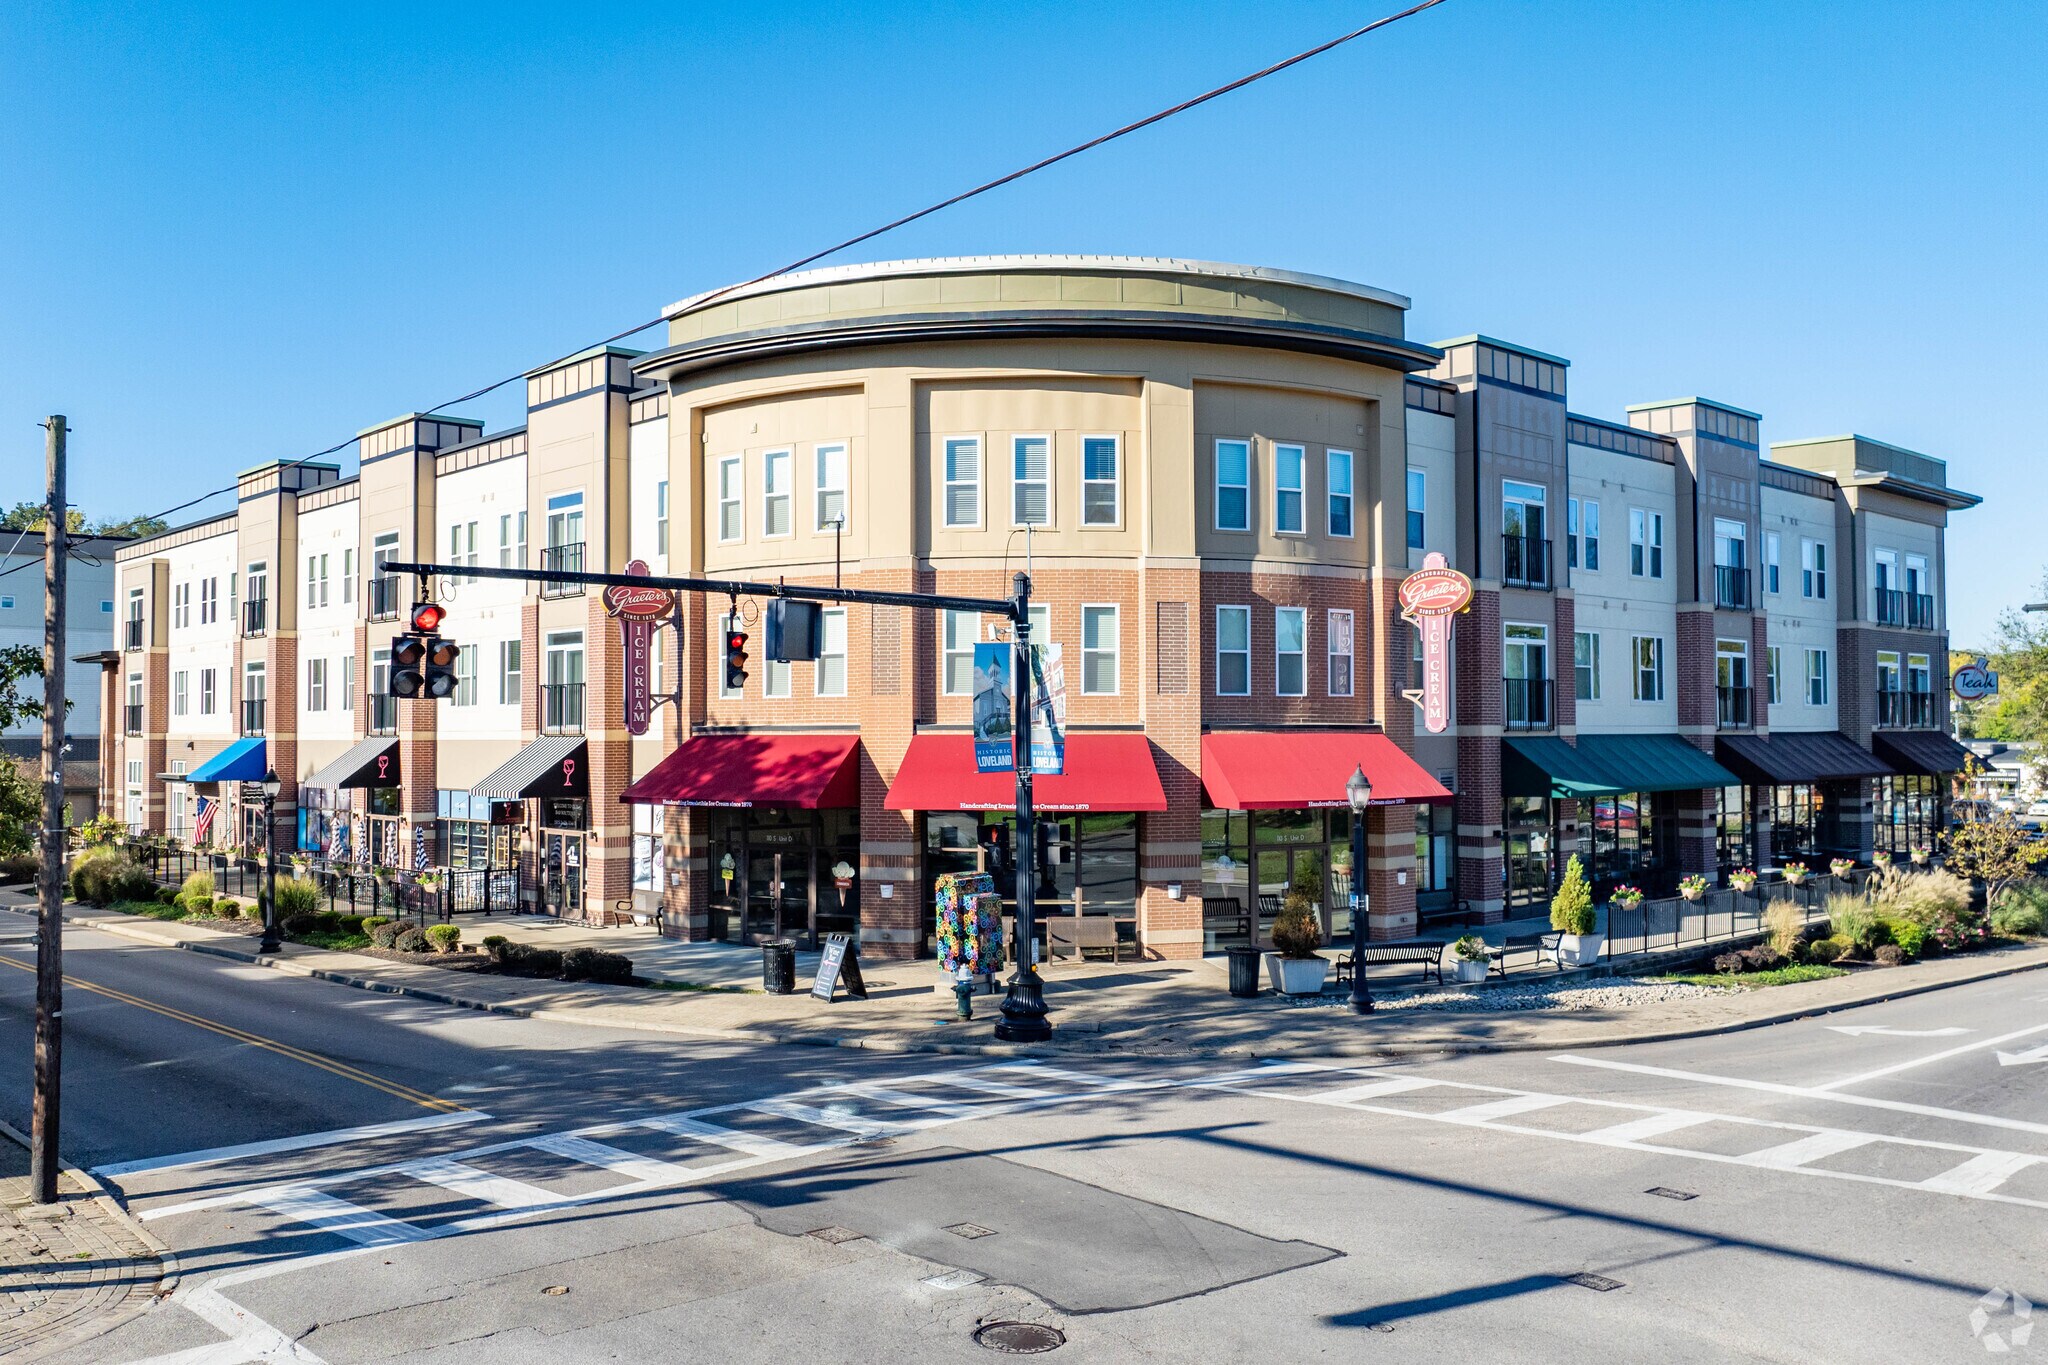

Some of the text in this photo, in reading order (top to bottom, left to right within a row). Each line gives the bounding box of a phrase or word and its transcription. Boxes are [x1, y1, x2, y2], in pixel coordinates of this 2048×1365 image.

[1413, 571, 1456, 581] HANDCRAFTED
[608, 586, 671, 617] Graeter's
[1437, 607, 1451, 615] 1870
[624, 613, 640, 621] SINCE
[633, 626, 645, 722] ICE CREAM
[1429, 620, 1441, 718] ICE CREAM
[1960, 672, 1995, 688] Teak
[978, 755, 1012, 767] LOVELAND
[1033, 757, 1063, 768] LOVELAND
[1060, 802, 1075, 810] since
